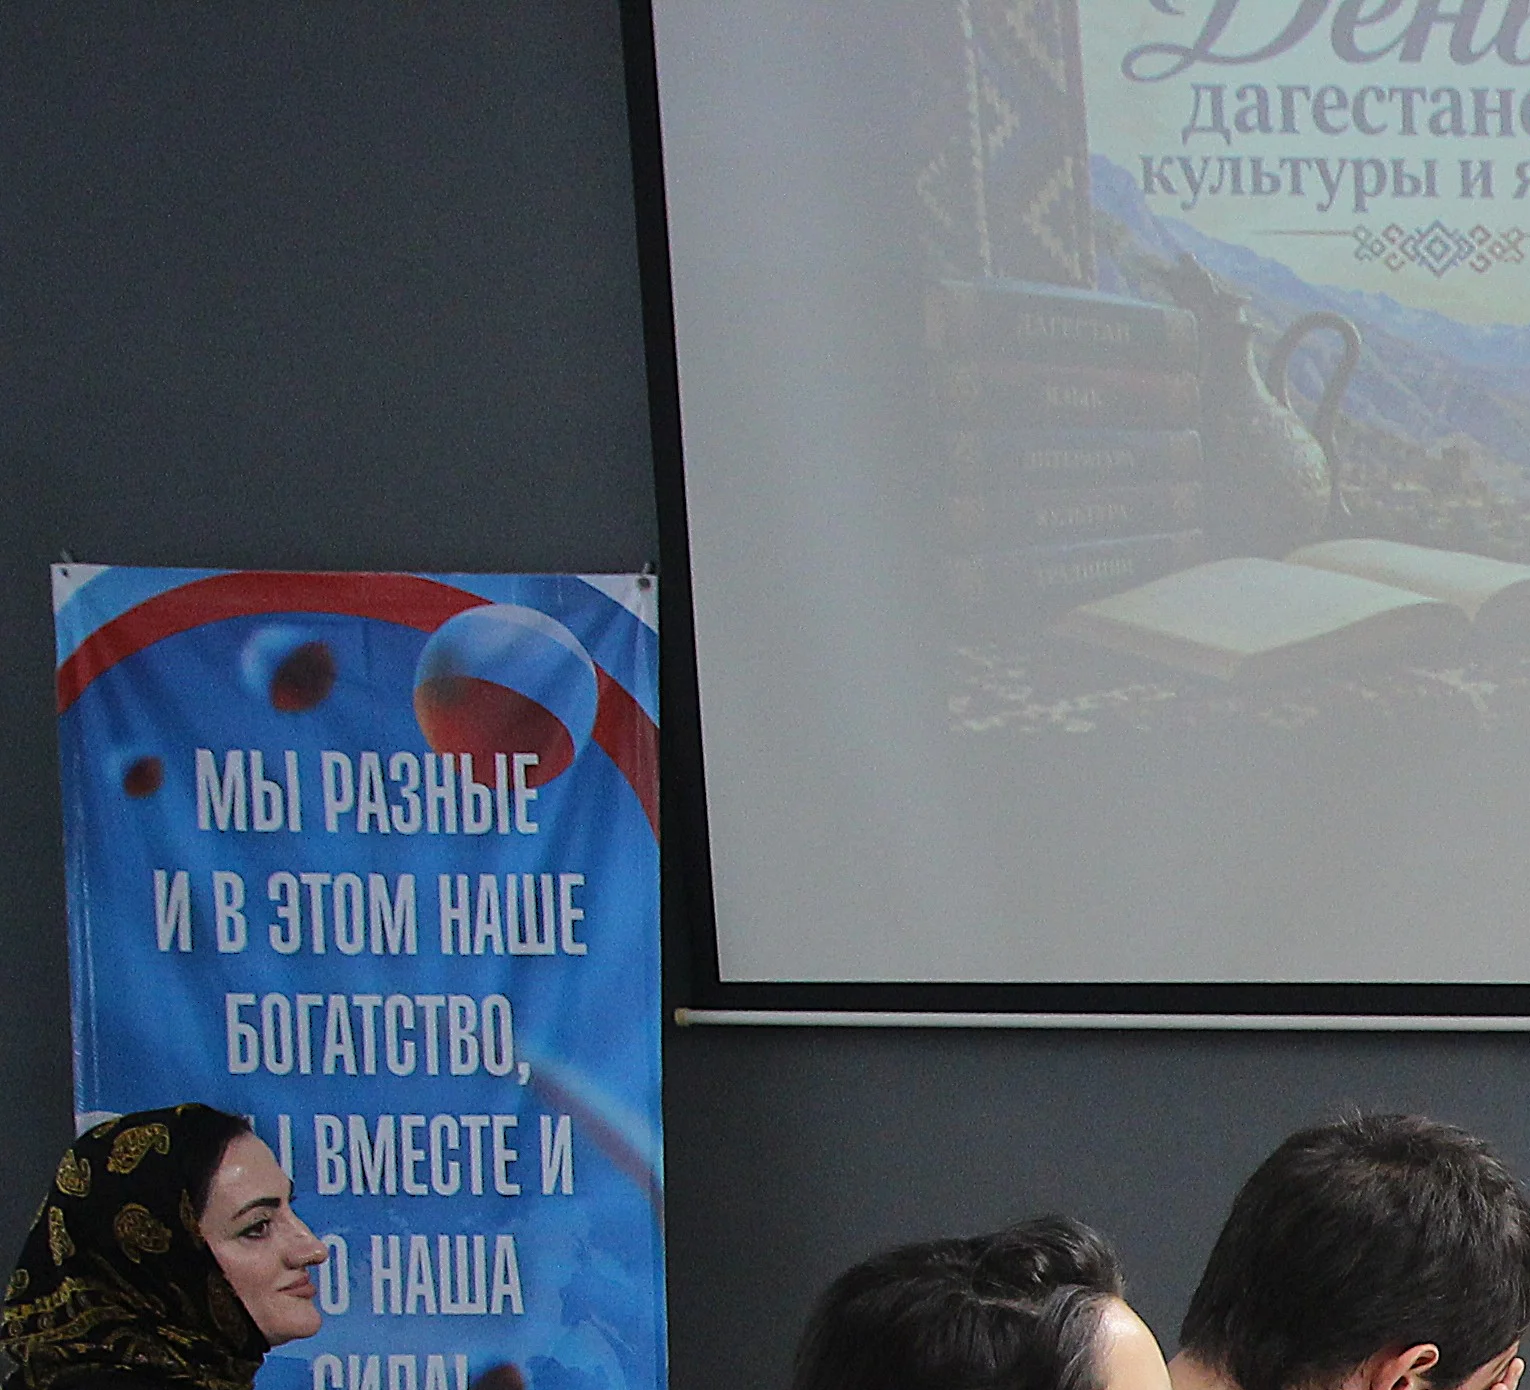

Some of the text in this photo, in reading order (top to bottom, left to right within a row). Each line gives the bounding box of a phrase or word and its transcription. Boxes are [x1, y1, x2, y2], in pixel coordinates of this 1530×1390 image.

[1139, 152, 1438, 212] культуры
[1459, 159, 1495, 199] и
[196, 749, 541, 836] МЫ РАЗНЫЕ
[152, 870, 588, 957] И В ЭТОМ НАШЕ
[225, 993, 532, 1087] БОГАТСТВО,
[316, 1114, 521, 1198] ВМЕСТЕ
[539, 1114, 575, 1196] И
[372, 1234, 525, 1316] НАША
